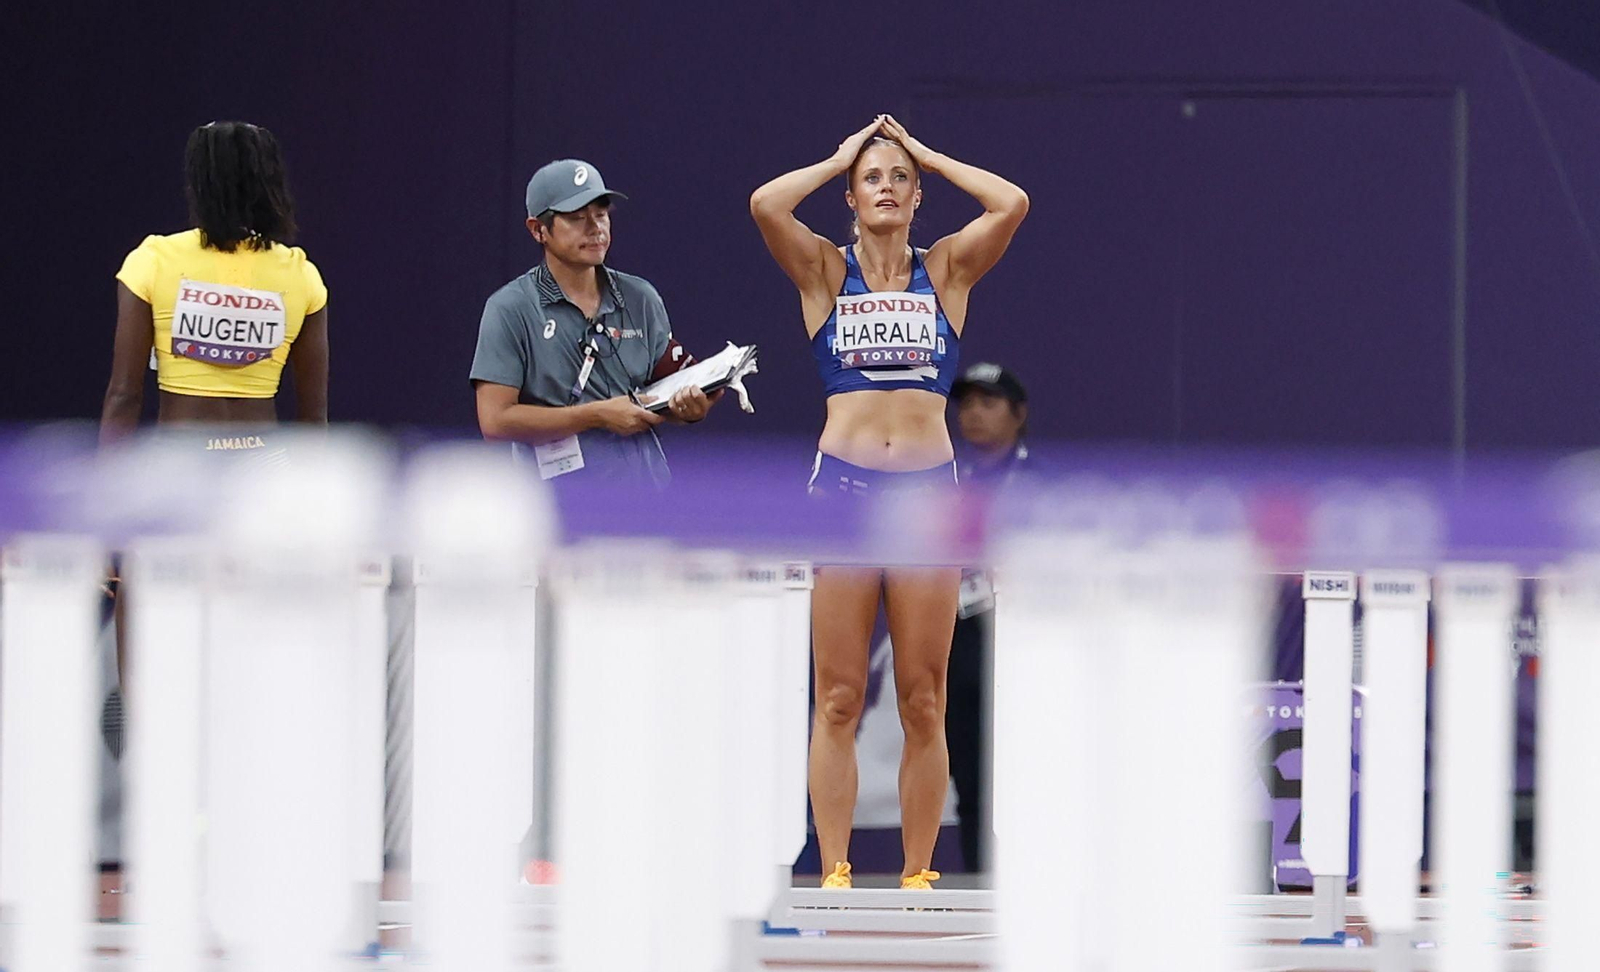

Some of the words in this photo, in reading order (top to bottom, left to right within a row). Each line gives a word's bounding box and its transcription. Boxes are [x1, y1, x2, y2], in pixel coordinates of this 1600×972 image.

[181, 288, 282, 311] HONDA
[839, 299, 933, 316] HONDA
[179, 313, 279, 344] NUGENT
[843, 322, 932, 347] HARALA
[205, 436, 266, 450] JAMAICA
[1309, 579, 1349, 592] NISHI
